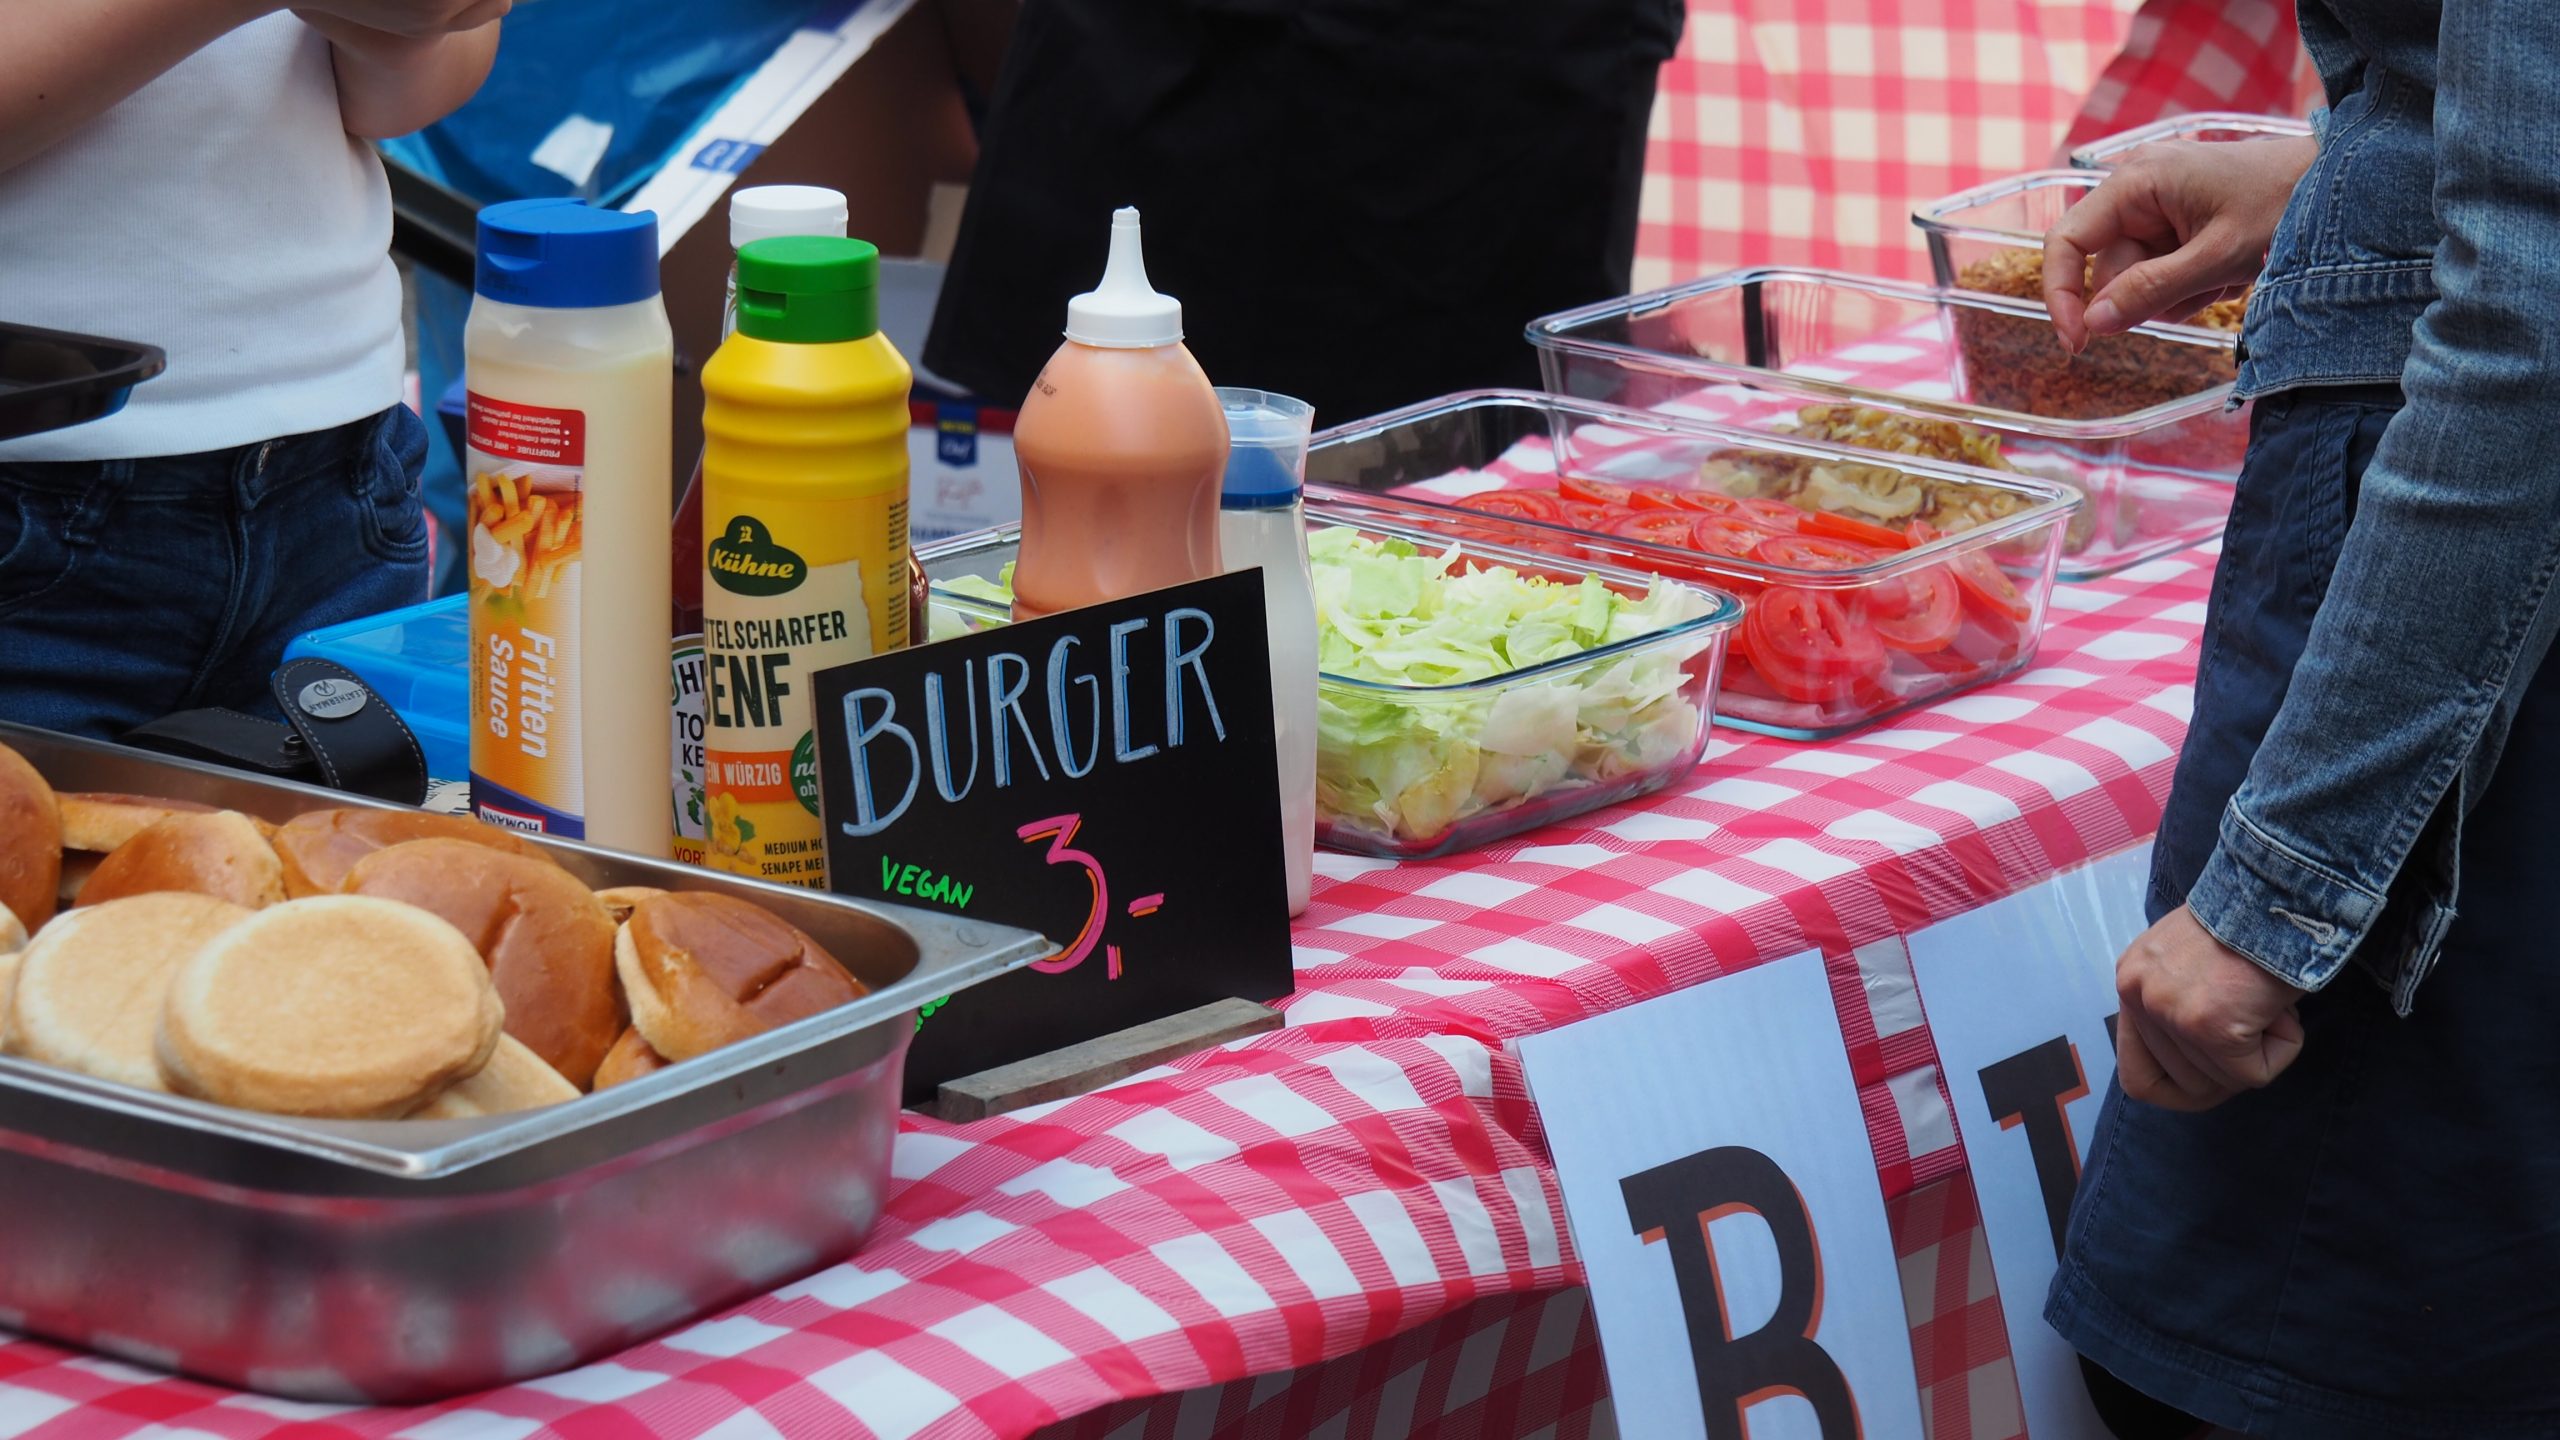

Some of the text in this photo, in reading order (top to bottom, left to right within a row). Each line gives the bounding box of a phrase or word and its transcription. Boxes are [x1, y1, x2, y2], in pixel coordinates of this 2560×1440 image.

[516, 445, 561, 458] PROFITUBE
[711, 547, 796, 580] Kühne
[489, 632, 516, 739] Sauce
[520, 627, 557, 759] Fritten
[676, 711, 705, 743] TO
[842, 608, 1227, 837] BURGER
[682, 743, 705, 768] KE
[723, 761, 783, 787] WÜRZIG
[764, 840, 808, 857] MEDIUM
[761, 860, 802, 876] SENAPE
[881, 855, 975, 910] VEGAN
[1618, 1144, 1866, 1440] B
